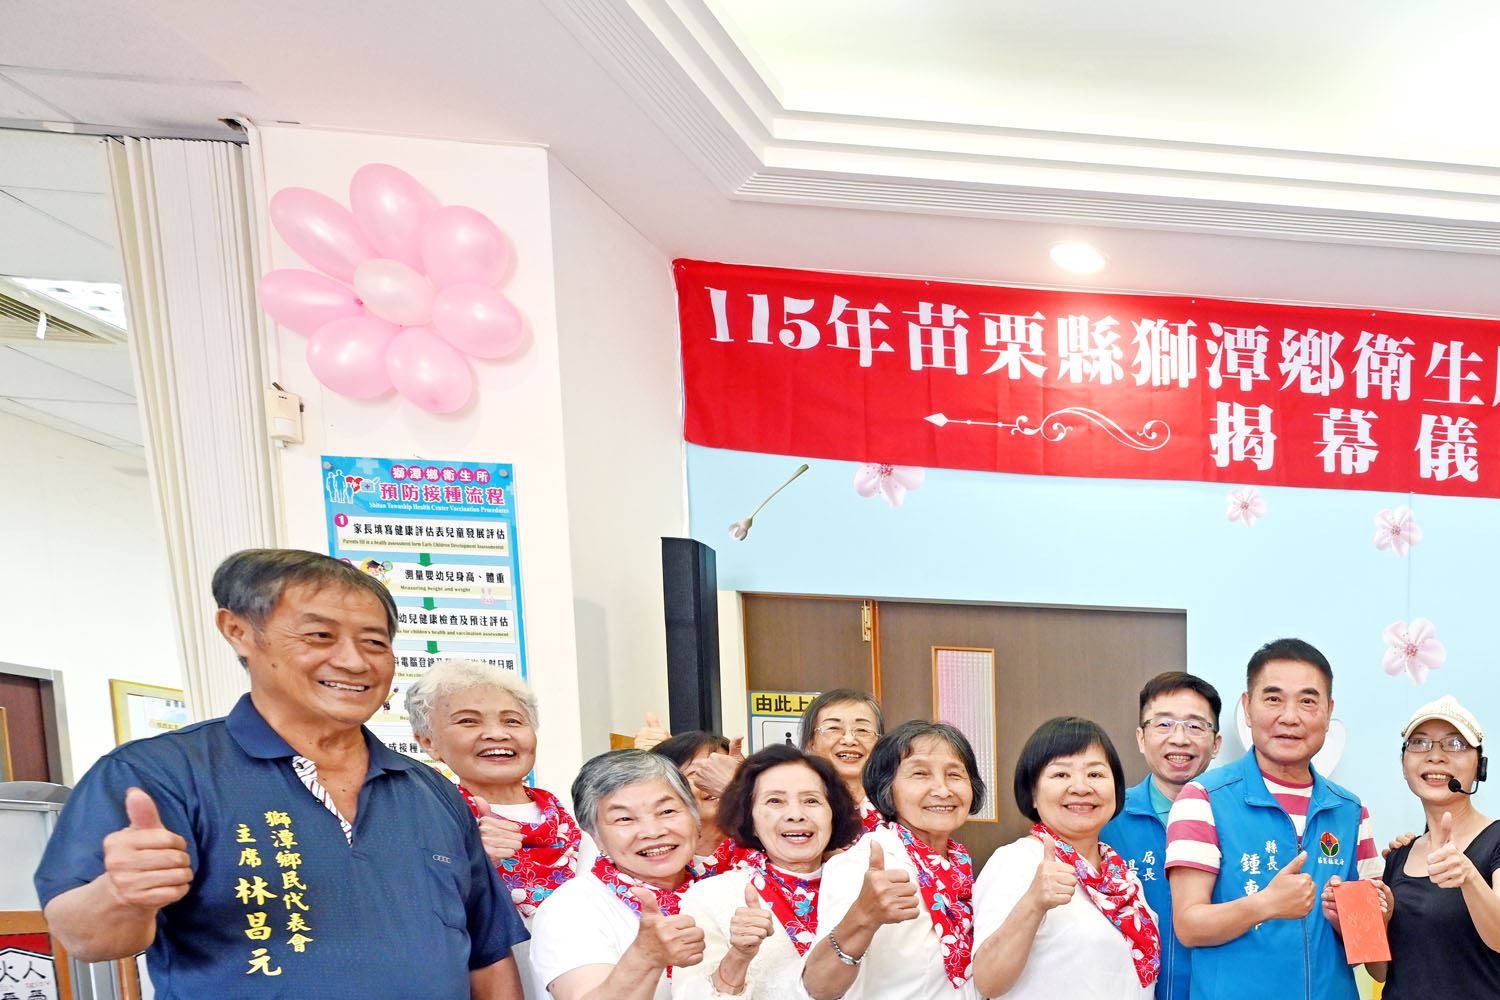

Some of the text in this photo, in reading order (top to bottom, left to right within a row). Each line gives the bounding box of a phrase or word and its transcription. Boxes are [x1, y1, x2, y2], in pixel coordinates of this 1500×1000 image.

[392, 467, 488, 483] 獅潭鄉衛生所
[380, 483, 505, 505] 預防接種流程
[353, 523, 505, 540] 家長填寫健康評估表兒童發展評估
[405, 569, 505, 584] 測量嬰幼兒身高、體重
[756, 694, 816, 713] 由此上
[1142, 850, 1157, 882] 局長
[1264, 839, 1280, 872] 縣長
[264, 810, 315, 953] 獅潭鄉民代表會
[1240, 852, 1263, 931] 鍾東
[234, 823, 283, 977] 主席林昌元
